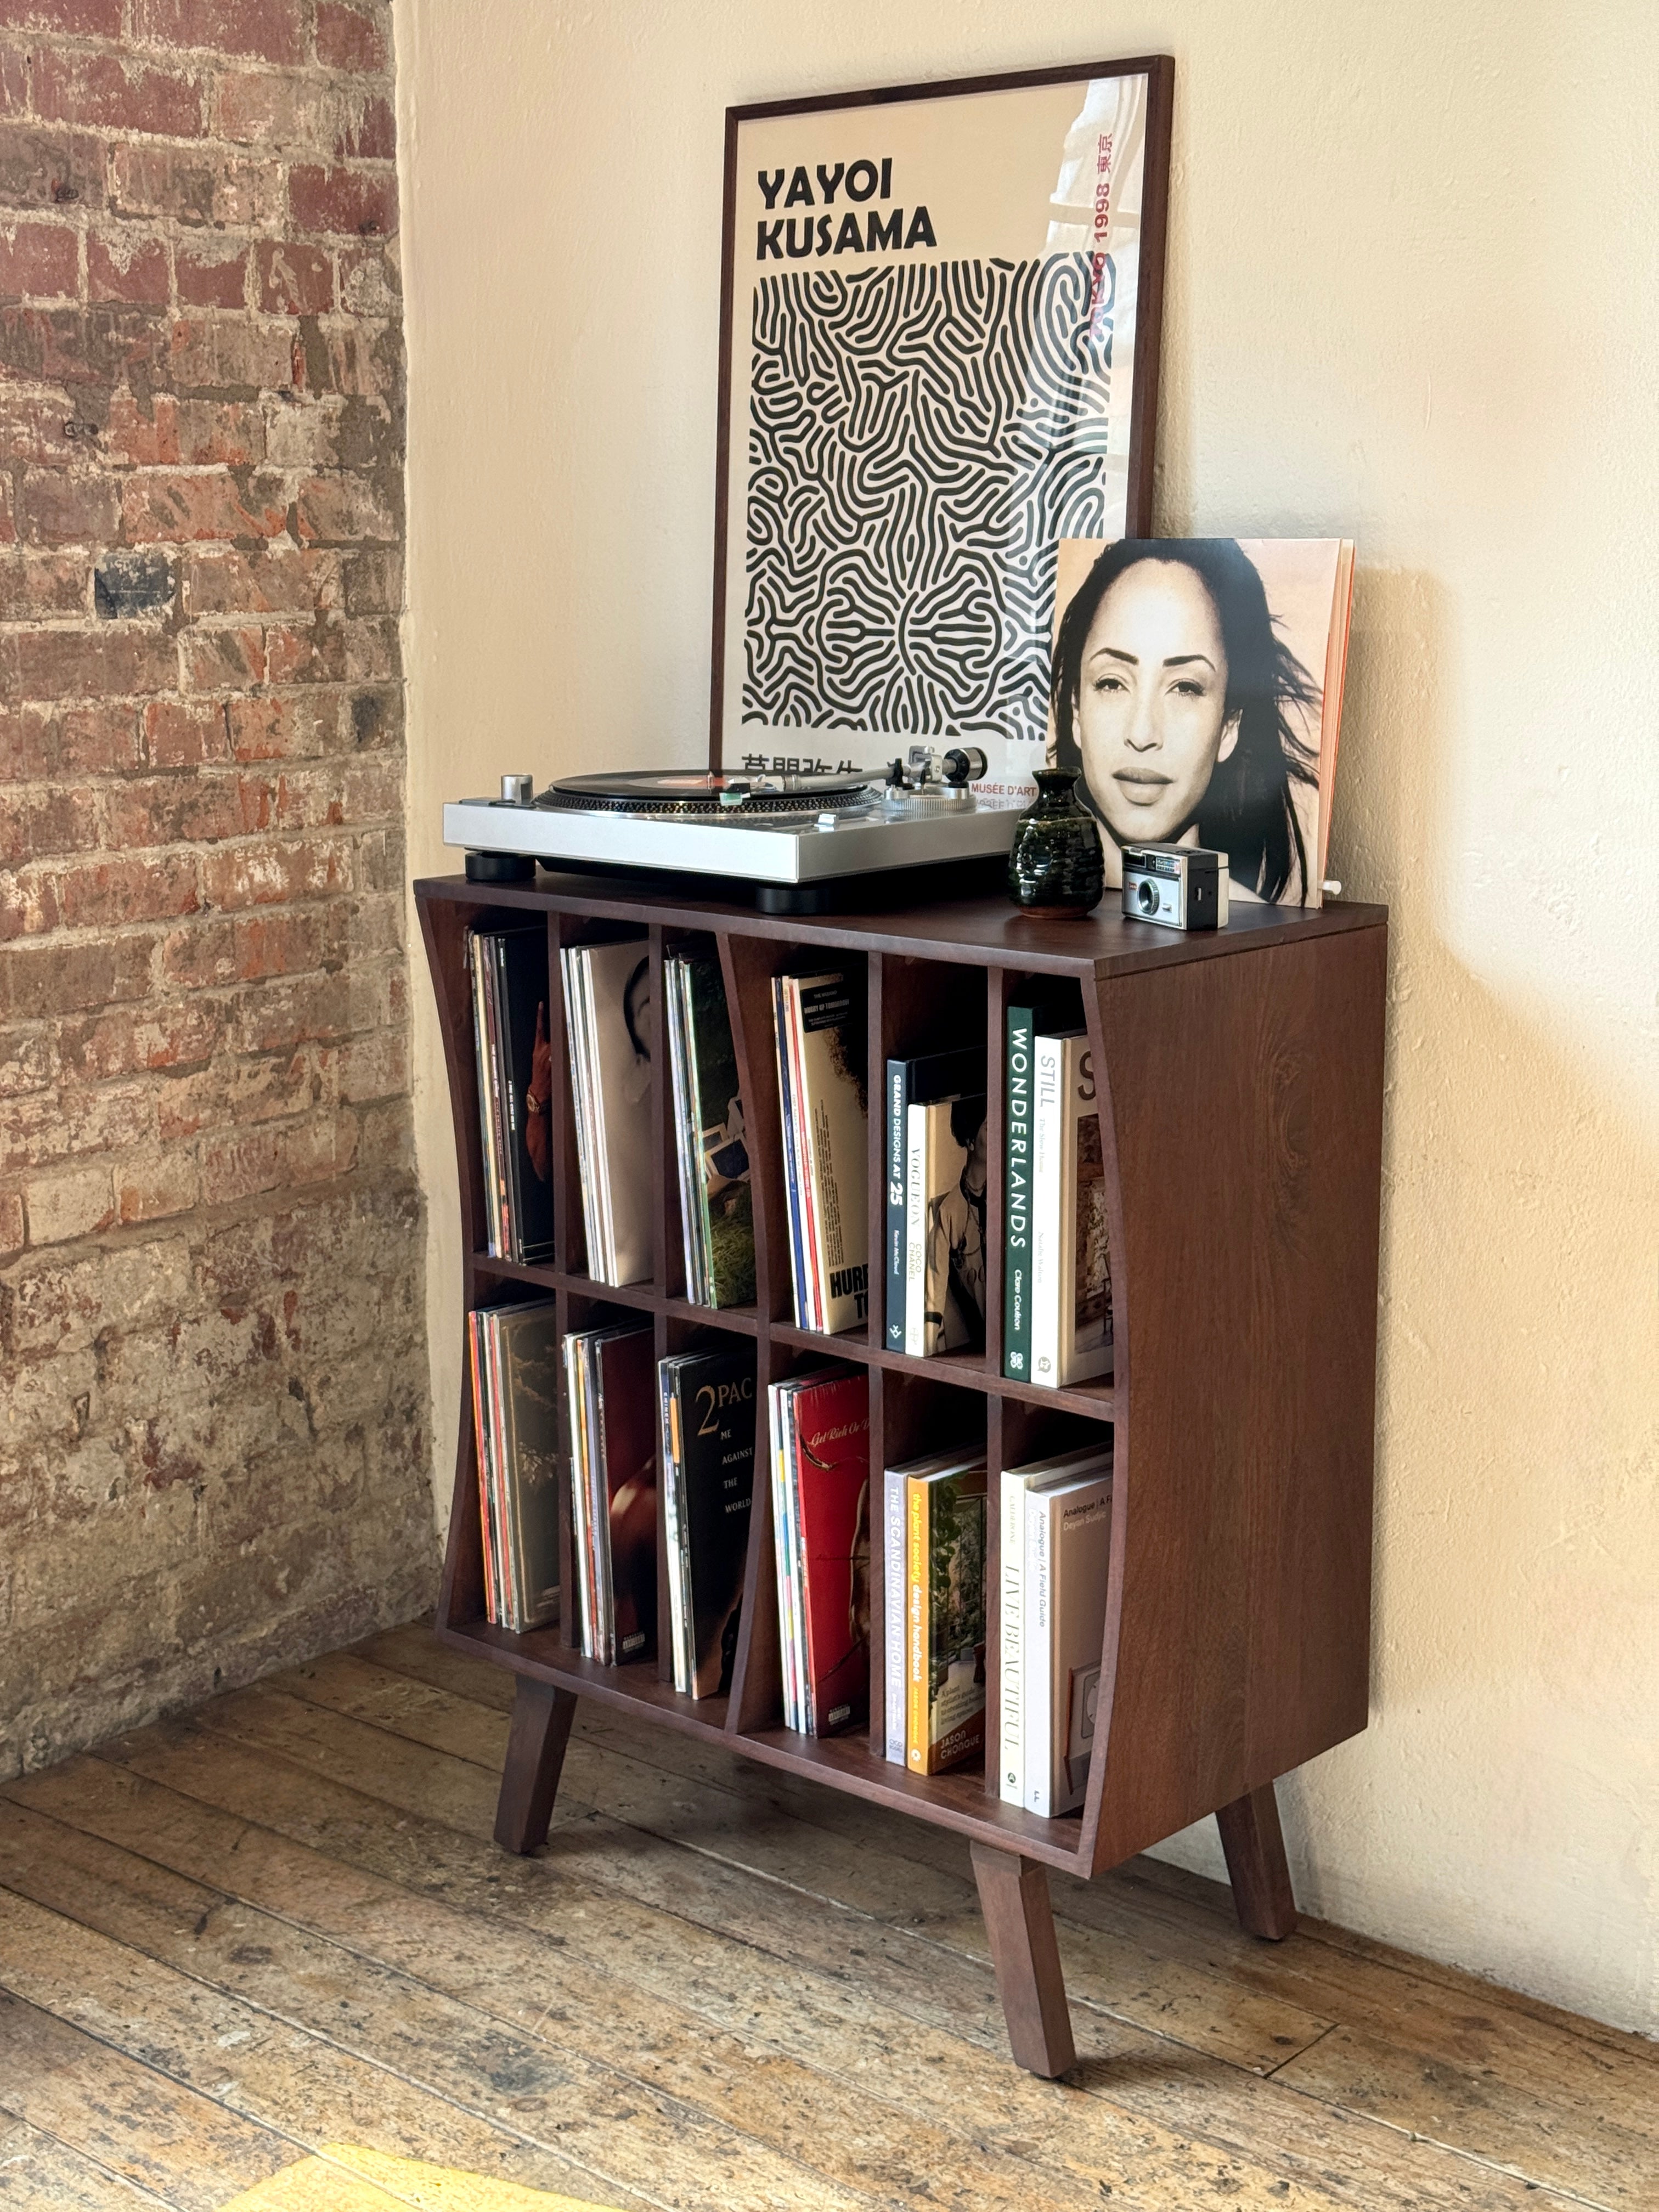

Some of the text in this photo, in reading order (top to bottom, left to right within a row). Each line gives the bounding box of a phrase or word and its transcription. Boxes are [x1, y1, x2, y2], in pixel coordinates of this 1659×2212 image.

[757, 157, 893, 210] YAYOI
[756, 206, 937, 261] KUSAMA
[1090, 133, 1113, 341] TOKYO 1998 東京
[971, 782, 1036, 797] MUSÉE D'ART
[1040, 1056, 1056, 1107] STILL
[890, 1075, 903, 1206] GRAND DESIGNS AT 25
[1010, 1028, 1028, 1249] WONDERLANDS
[1013, 1294, 1022, 1330] Coulson
[721, 1429, 732, 1441] ME
[807, 1431, 827, 1448] Get
[827, 1425, 848, 1440] Rich
[848, 1421, 860, 1435] Or
[721, 1447, 754, 1465] AGAINST
[723, 1477, 738, 1489] THE
[724, 1497, 752, 1514] WORLD
[1063, 1502, 1095, 1519] Analogue
[1099, 1497, 1105, 1506] A
[1038, 1511, 1046, 1557] Analogue
[1063, 1511, 1106, 1531] Deyan Sudjic
[889, 1487, 901, 1688] THE SCANDINAVIAN HOME
[911, 1493, 922, 1682] the plant society design handbook
[1039, 1573, 1047, 1597] Field
[1039, 1598, 1047, 1628] Guide
[1004, 1565, 1020, 1750] LIVE BEAUTIFUL
[940, 1729, 966, 1749] JASON
[940, 1734, 980, 1759] CHONGUE
